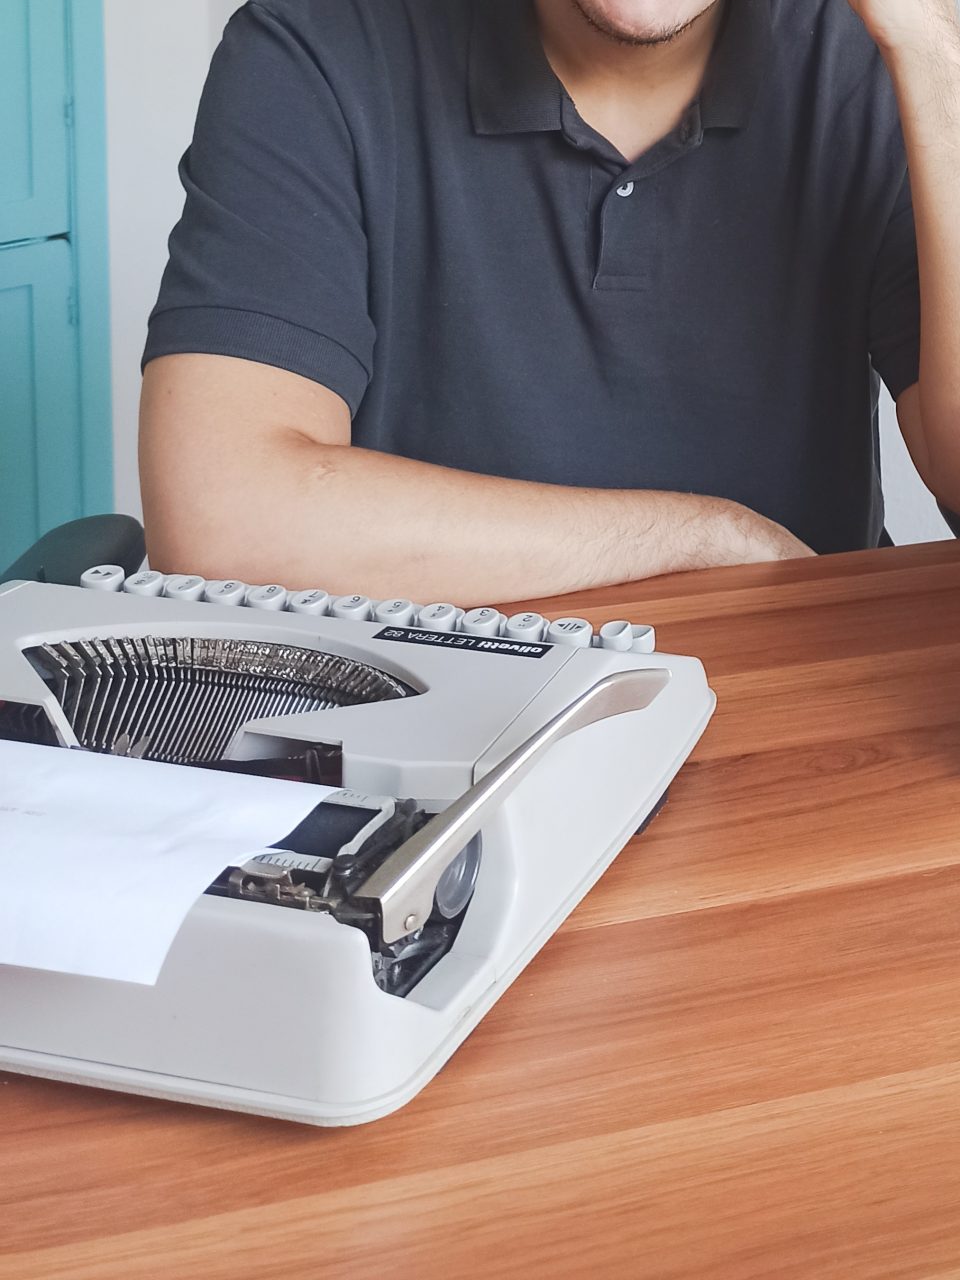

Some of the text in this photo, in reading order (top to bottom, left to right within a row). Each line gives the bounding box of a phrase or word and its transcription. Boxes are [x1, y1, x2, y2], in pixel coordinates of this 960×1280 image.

[383, 629, 543, 655] olivetti LETTERA 82
